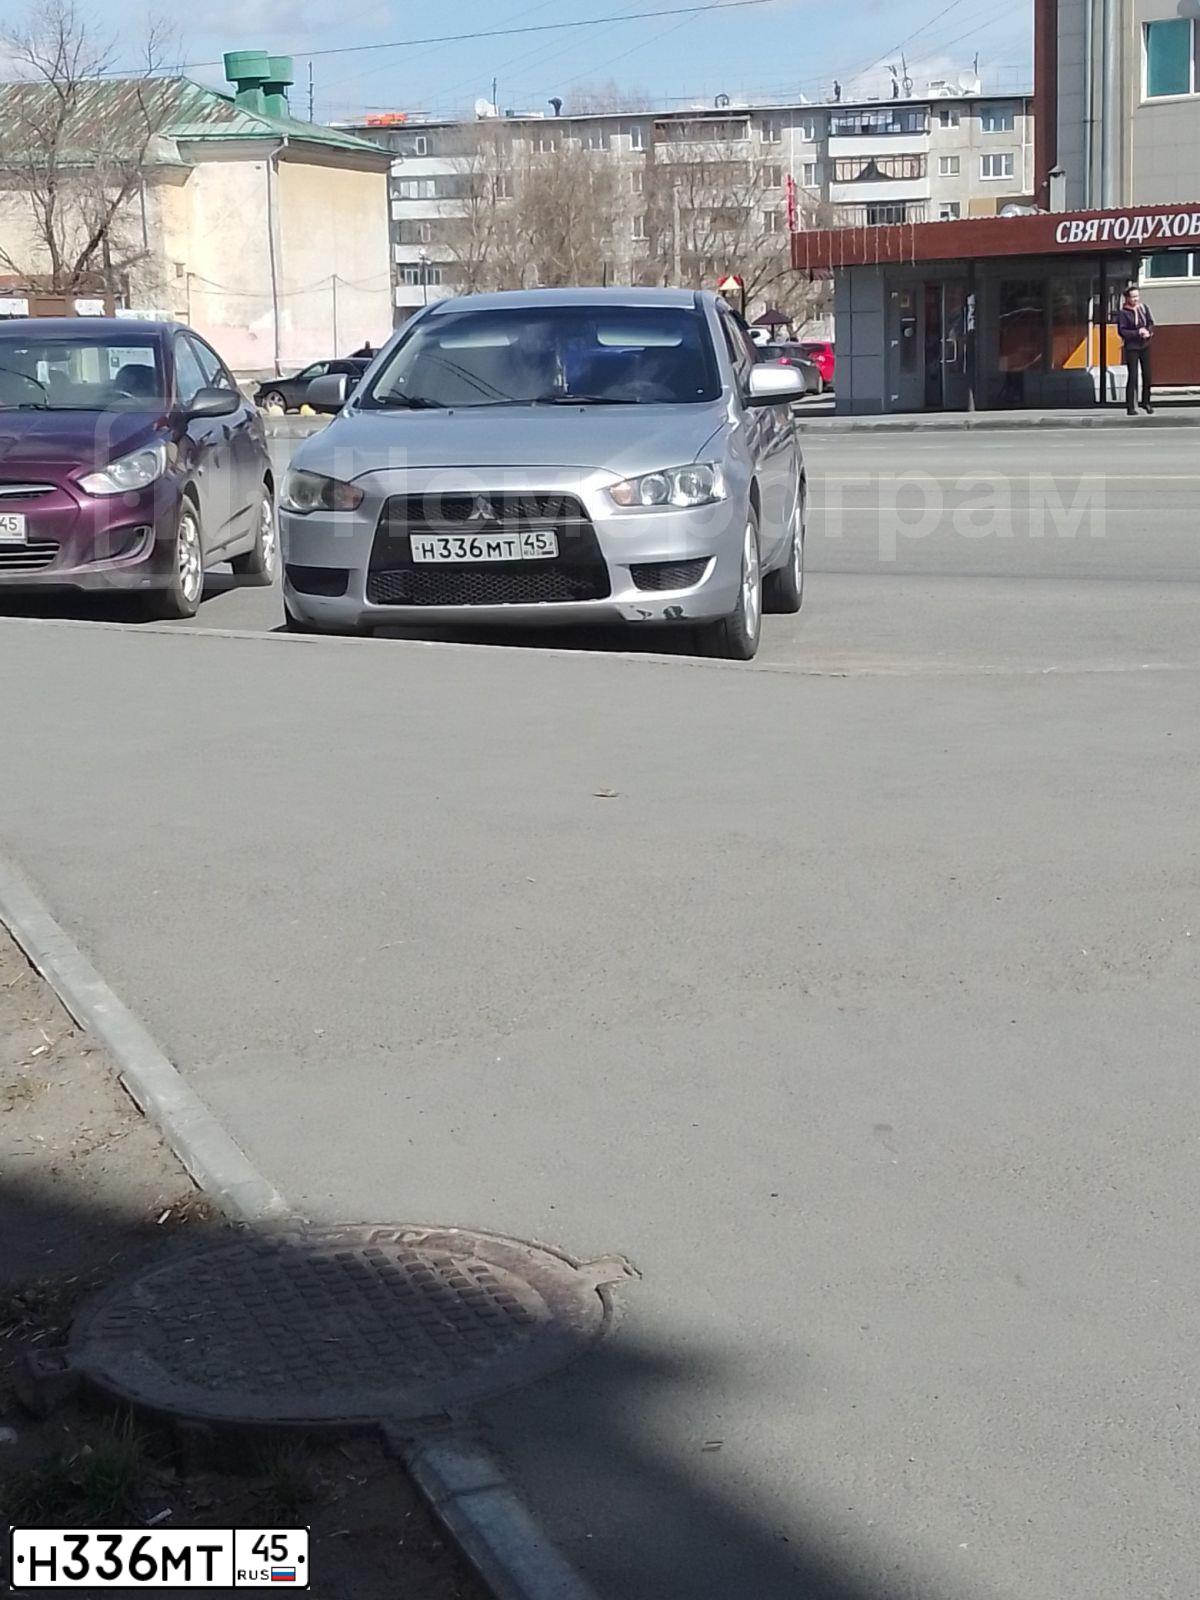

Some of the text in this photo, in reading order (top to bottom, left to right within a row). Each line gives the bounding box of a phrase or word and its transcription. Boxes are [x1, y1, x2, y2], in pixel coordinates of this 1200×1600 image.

[1056, 213, 1200, 244] СВЯТОДУХОВ
[0, 516, 18, 531] 45
[421, 534, 547, 559] Н336МТ 45
